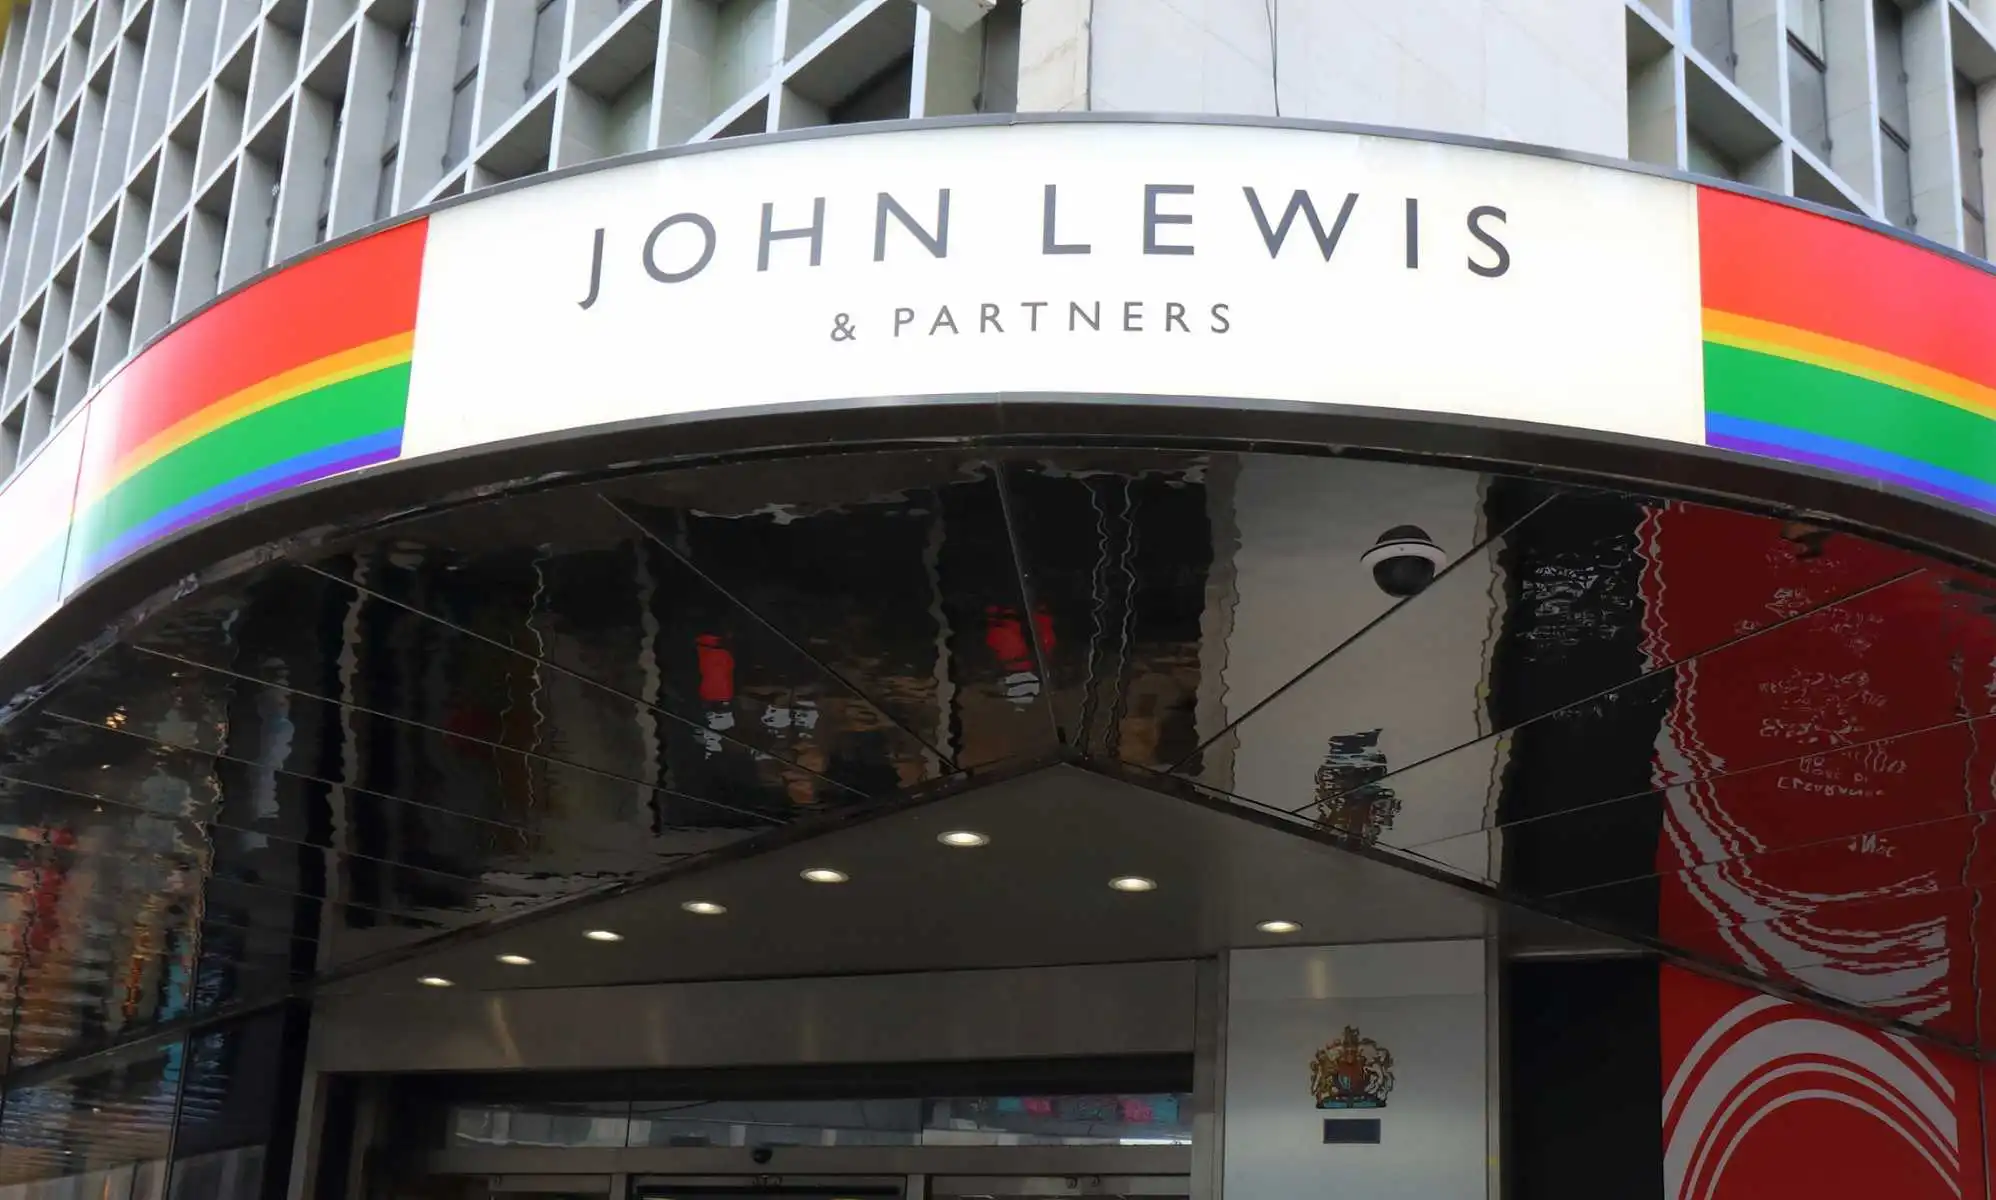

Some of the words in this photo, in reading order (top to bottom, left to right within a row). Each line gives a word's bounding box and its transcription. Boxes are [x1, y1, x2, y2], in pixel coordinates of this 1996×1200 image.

[577, 188, 951, 311] JOHN
[1042, 183, 1511, 279] LEWIS
[830, 312, 857, 342] &
[894, 301, 1231, 337] PARTNERS
